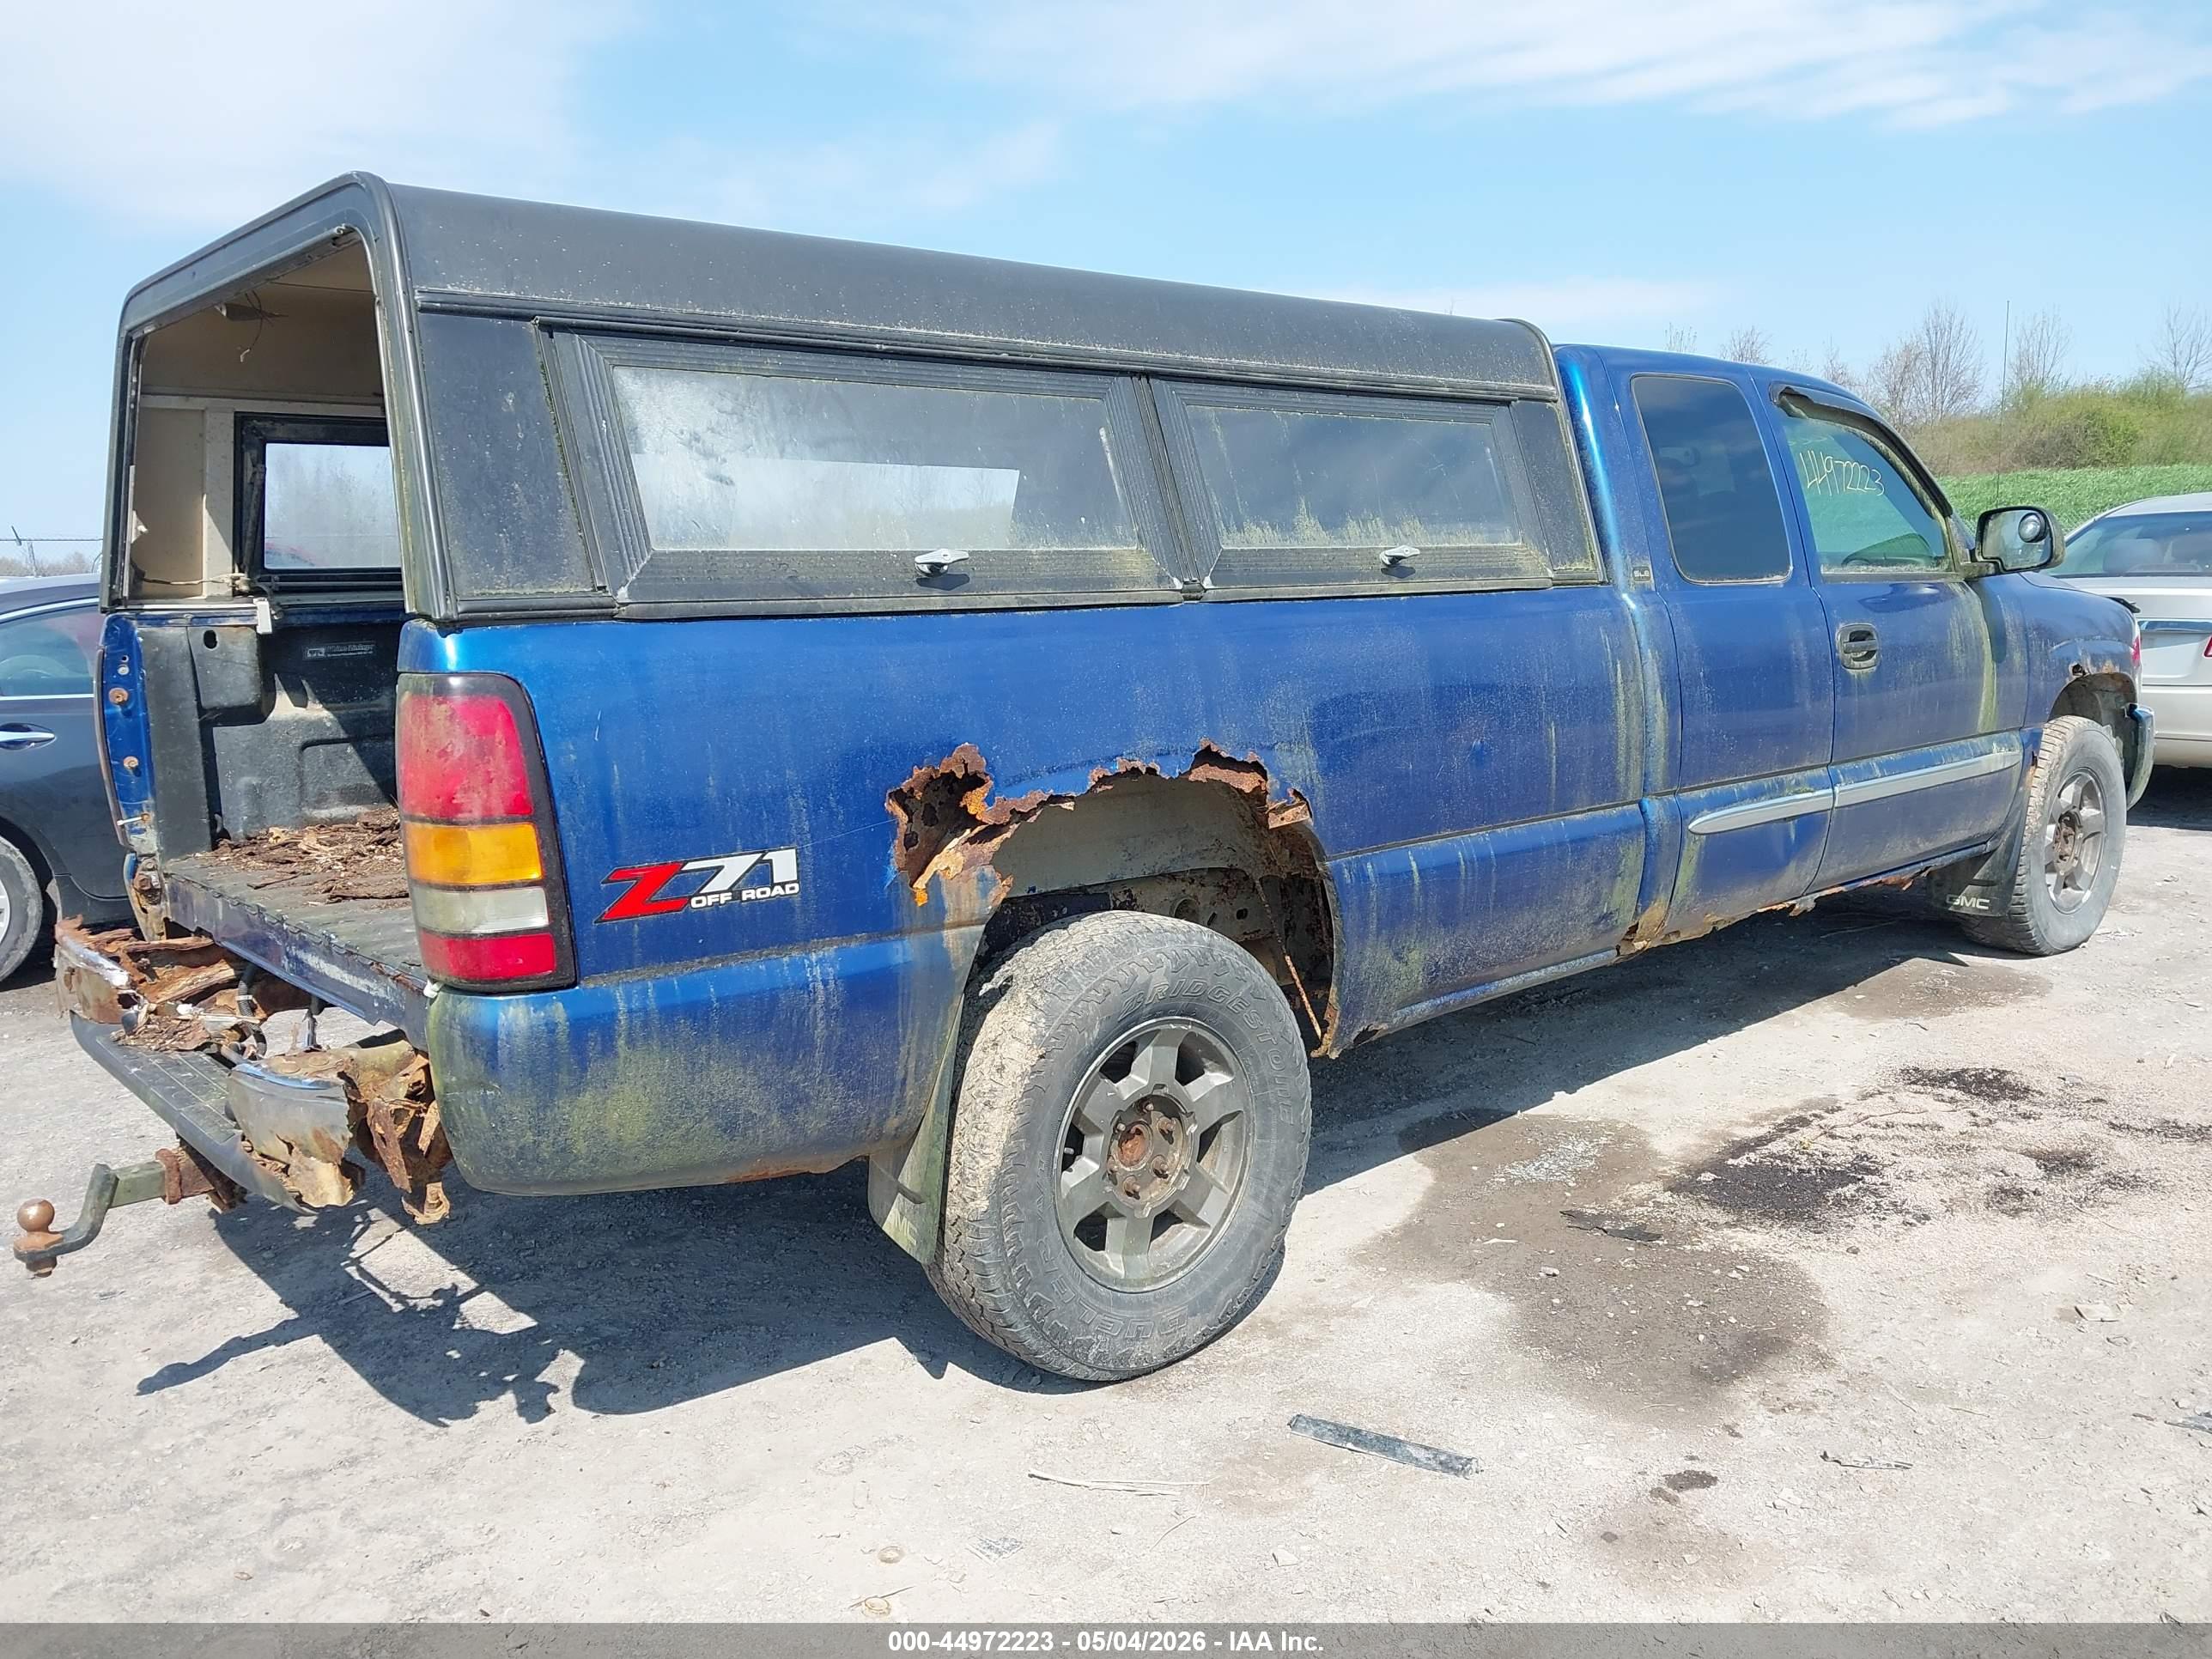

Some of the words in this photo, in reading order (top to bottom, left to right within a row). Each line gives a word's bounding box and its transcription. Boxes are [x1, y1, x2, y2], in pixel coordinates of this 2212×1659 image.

[1799, 450, 1885, 496] 44972223
[599, 848, 799, 922] Z71
[690, 891, 732, 909] OFF
[741, 882, 800, 902] ROAD
[1946, 894, 1990, 910] GMC
[1117, 976, 1294, 1127] BRIDGESTONE
